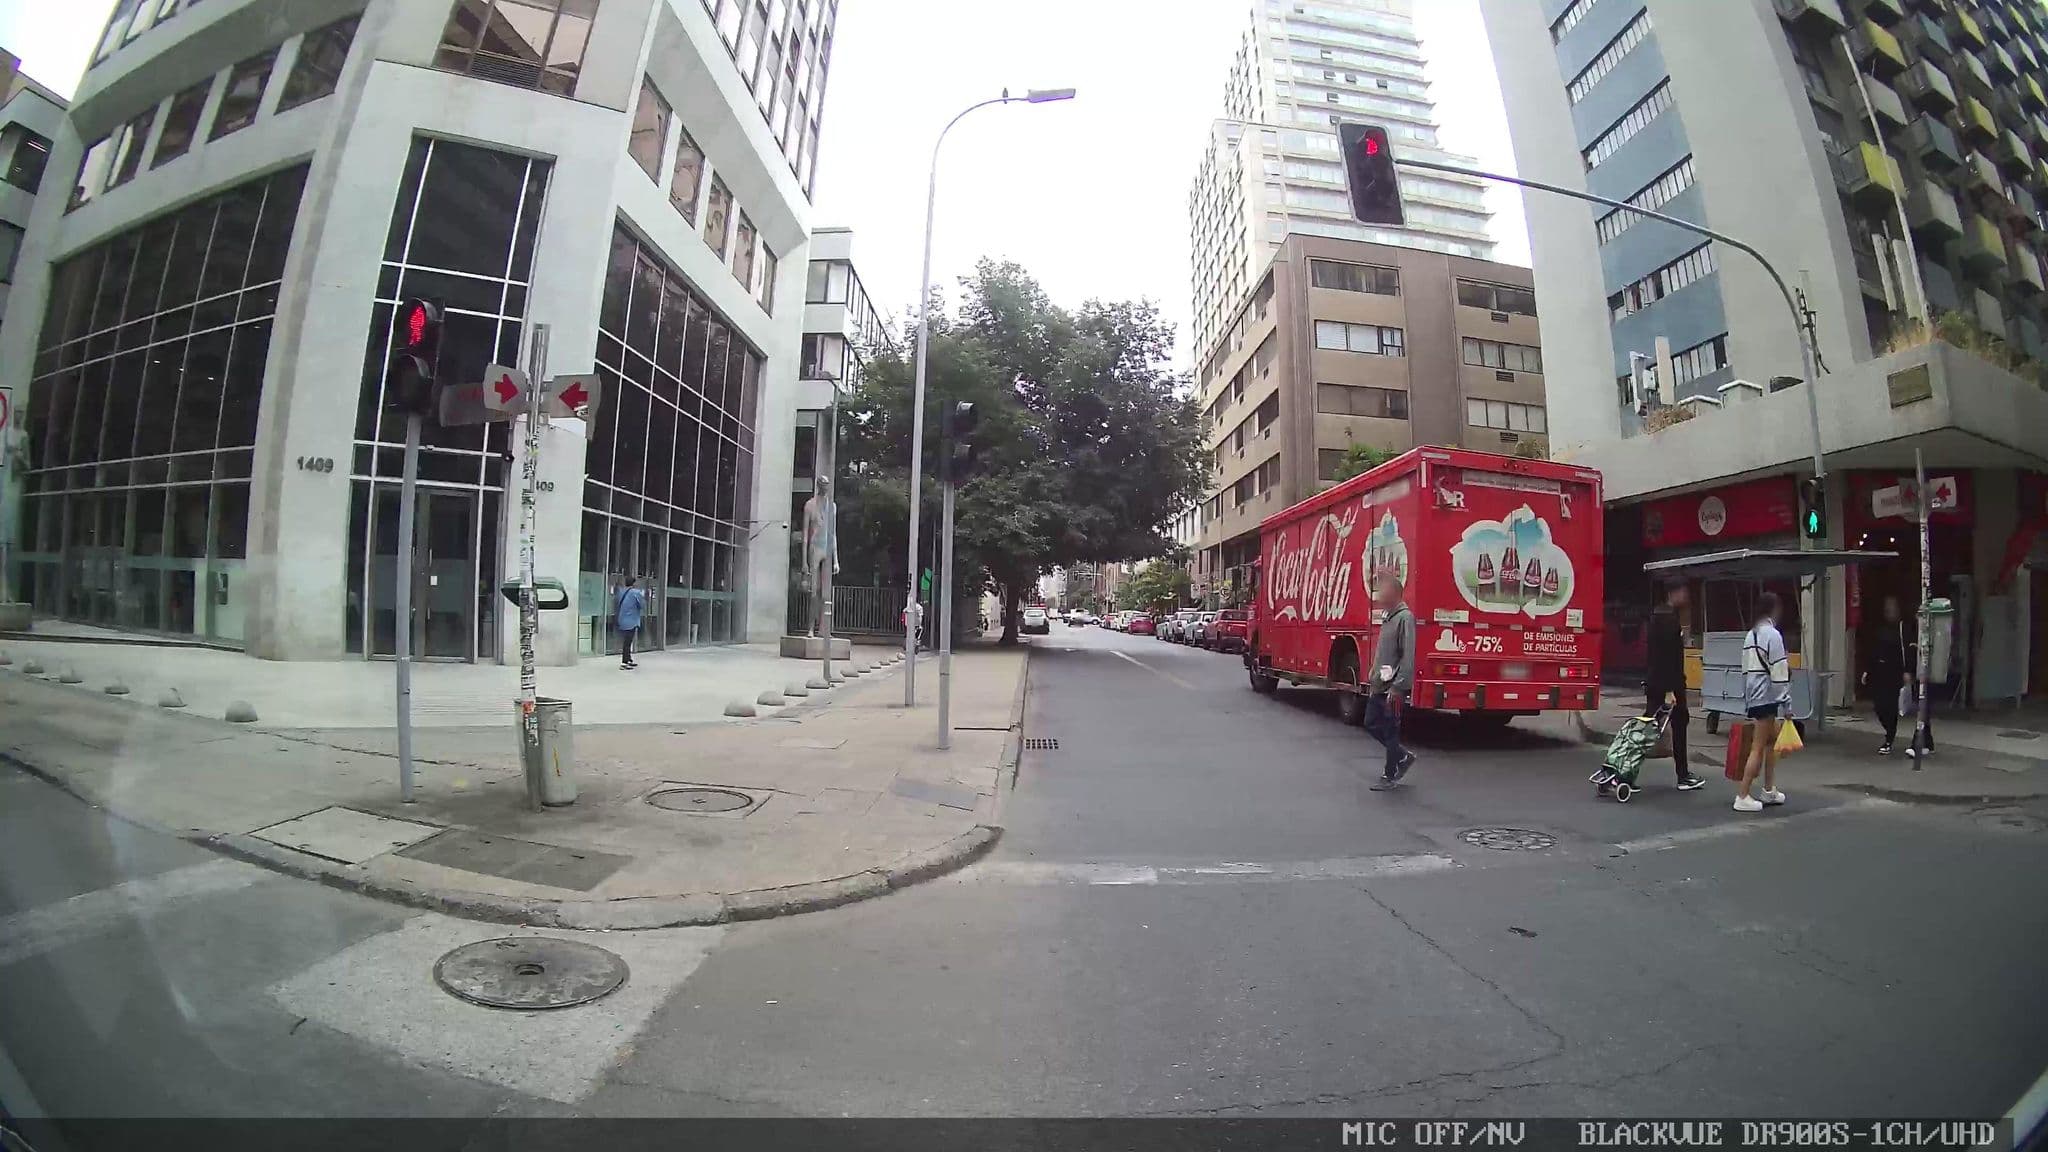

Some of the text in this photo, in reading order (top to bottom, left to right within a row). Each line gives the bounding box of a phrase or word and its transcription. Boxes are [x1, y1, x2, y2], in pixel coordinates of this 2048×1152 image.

[297, 456, 334, 474] 1409
[1467, 635, 1503, 653] -75%
[1523, 631, 1575, 643] DE EMISIONES
[1523, 641, 1577, 653] DE PARTÍCULAS
